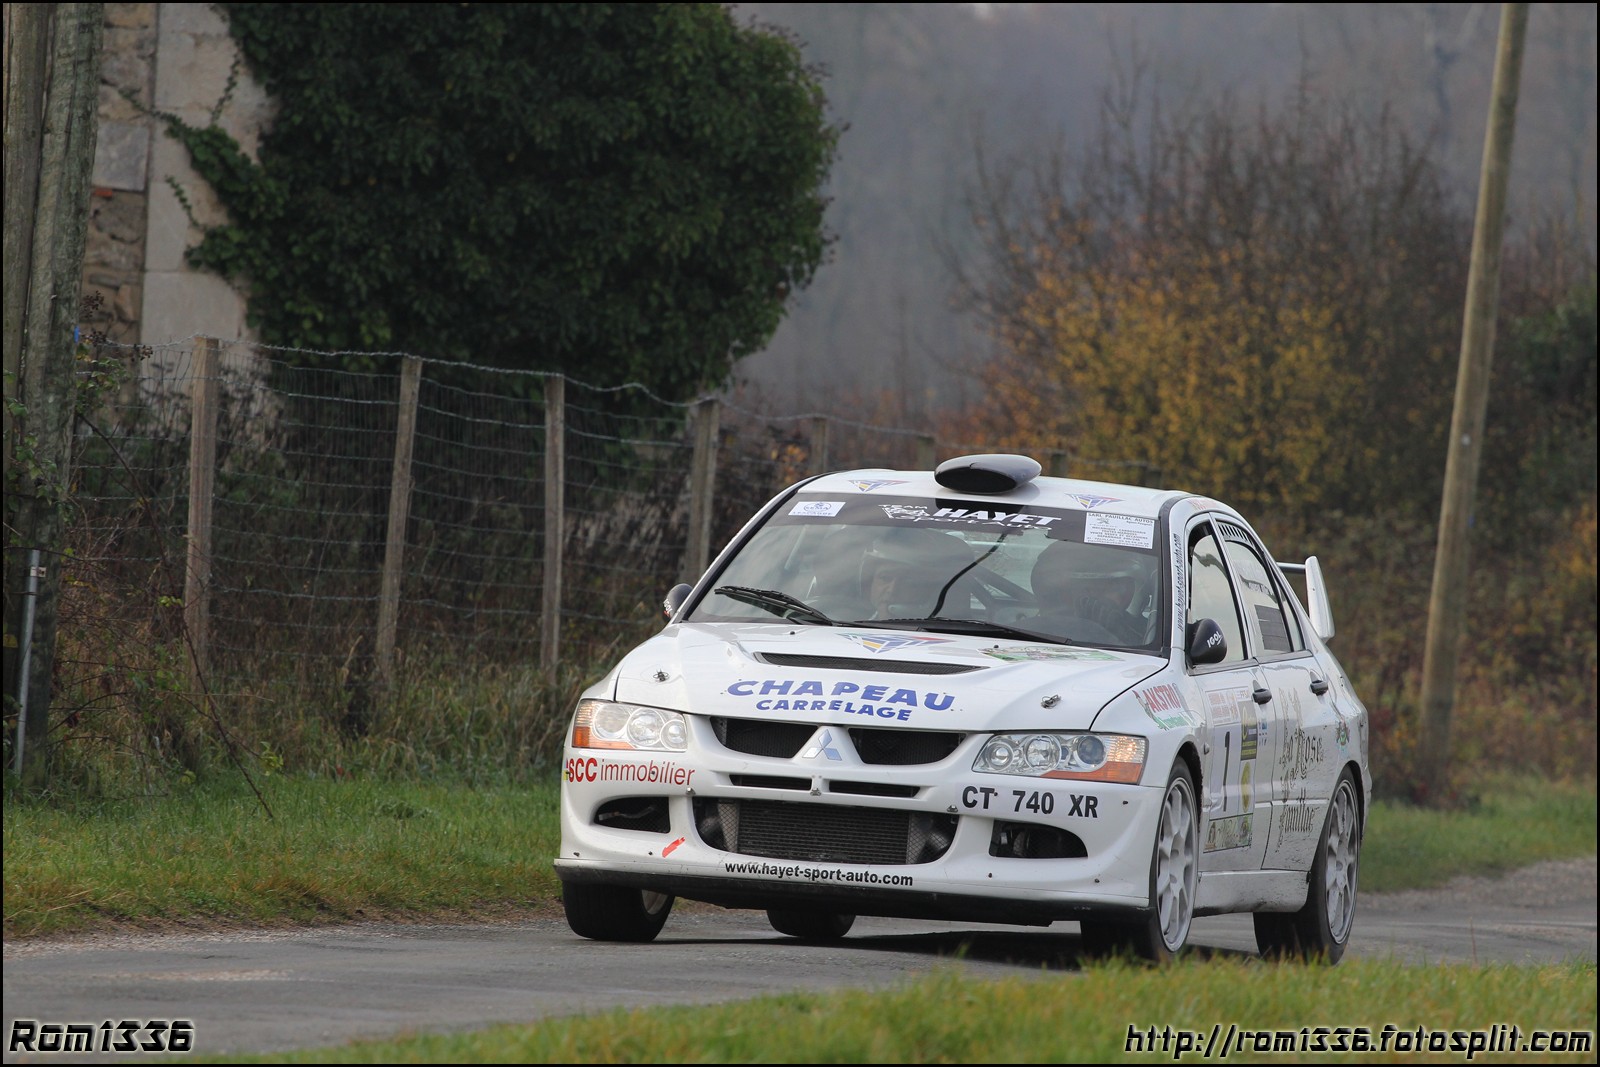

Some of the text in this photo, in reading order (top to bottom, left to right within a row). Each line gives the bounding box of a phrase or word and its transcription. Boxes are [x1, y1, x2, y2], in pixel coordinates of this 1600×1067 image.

[933, 508, 1062, 525] HAYET
[1206, 631, 1223, 648] IGOL
[727, 680, 955, 712] CHAPEAU
[756, 699, 912, 722] CARRELAGE
[600, 760, 695, 786] immobilier
[1223, 731, 1230, 812] 1
[962, 786, 1099, 818] CT 740 XR
[724, 862, 914, 887] www.hayet-sport-auto.com
